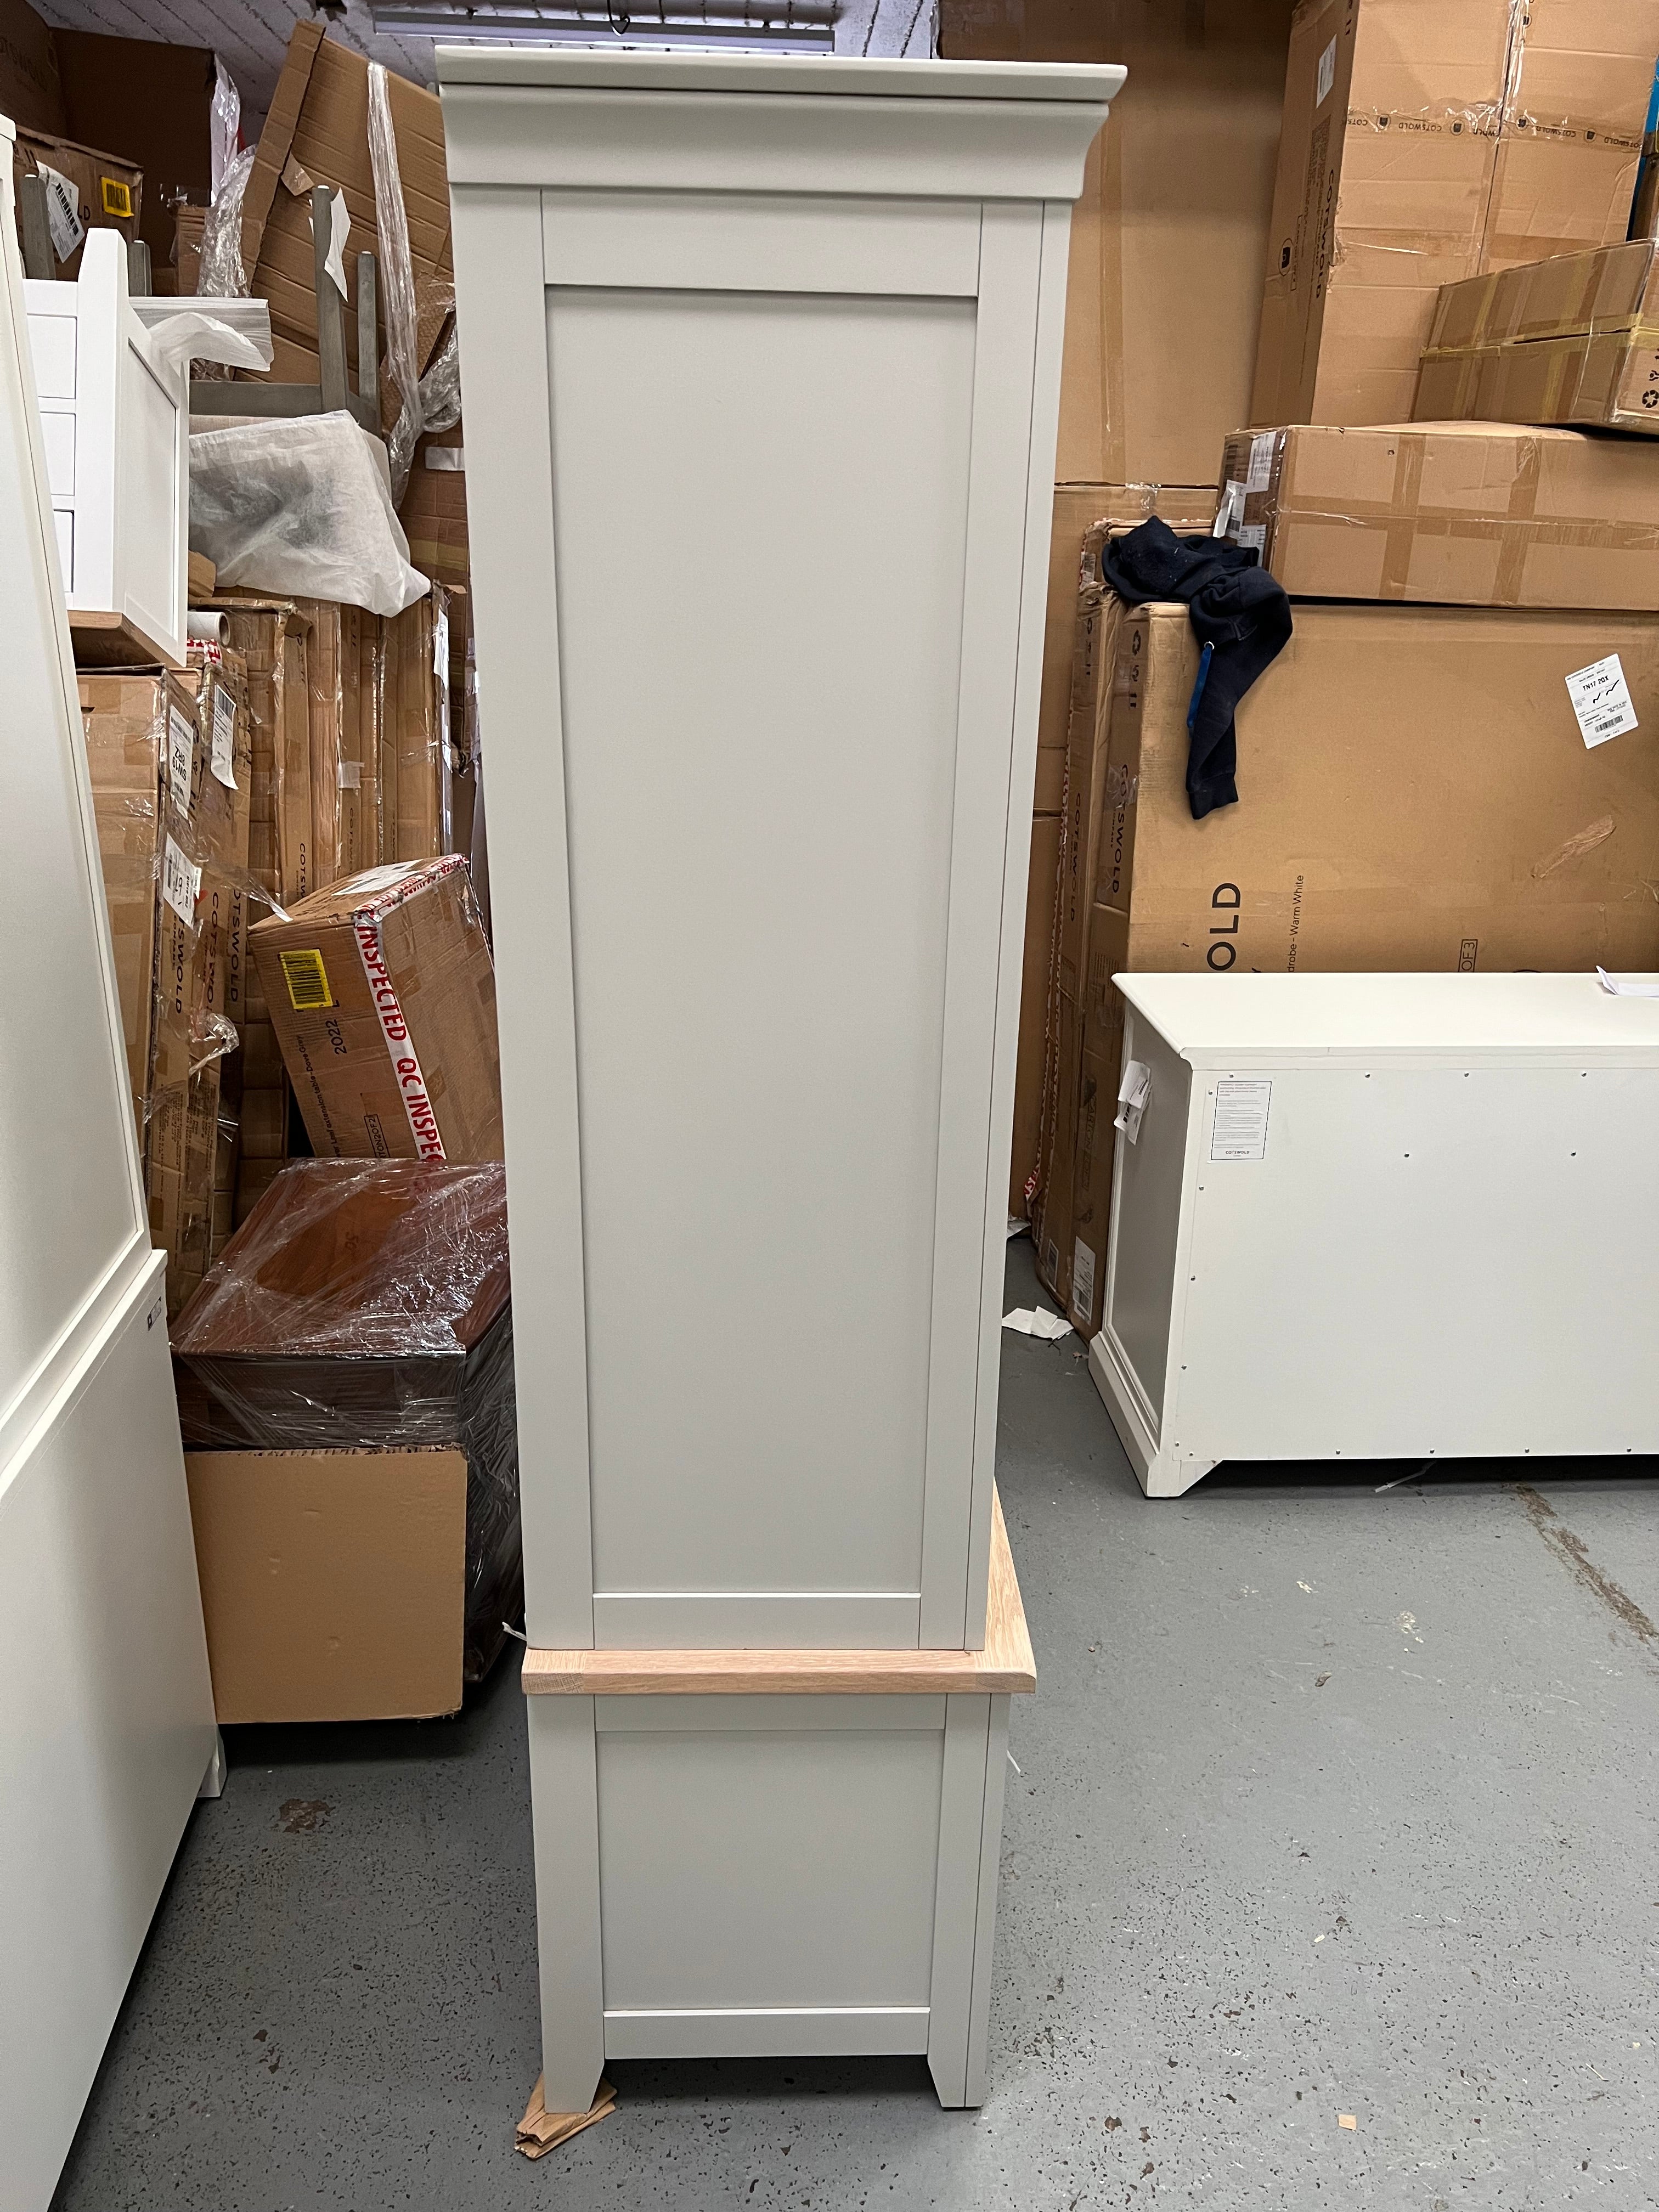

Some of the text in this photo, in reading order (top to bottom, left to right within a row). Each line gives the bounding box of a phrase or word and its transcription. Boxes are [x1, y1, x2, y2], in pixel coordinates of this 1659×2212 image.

[1398, 122, 1442, 132] COTSWOLD
[1583, 680, 1596, 691] TN17
[1292, 875, 1304, 904] White
[1289, 907, 1301, 935] Warm
[357, 926, 407, 1041] INSPECTED
[397, 1058, 422, 1088] QC
[325, 1019, 347, 1055] 2022
[303, 1053, 313, 1071] Dove
[310, 1075, 321, 1094] table
[317, 1094, 332, 1127] extension
